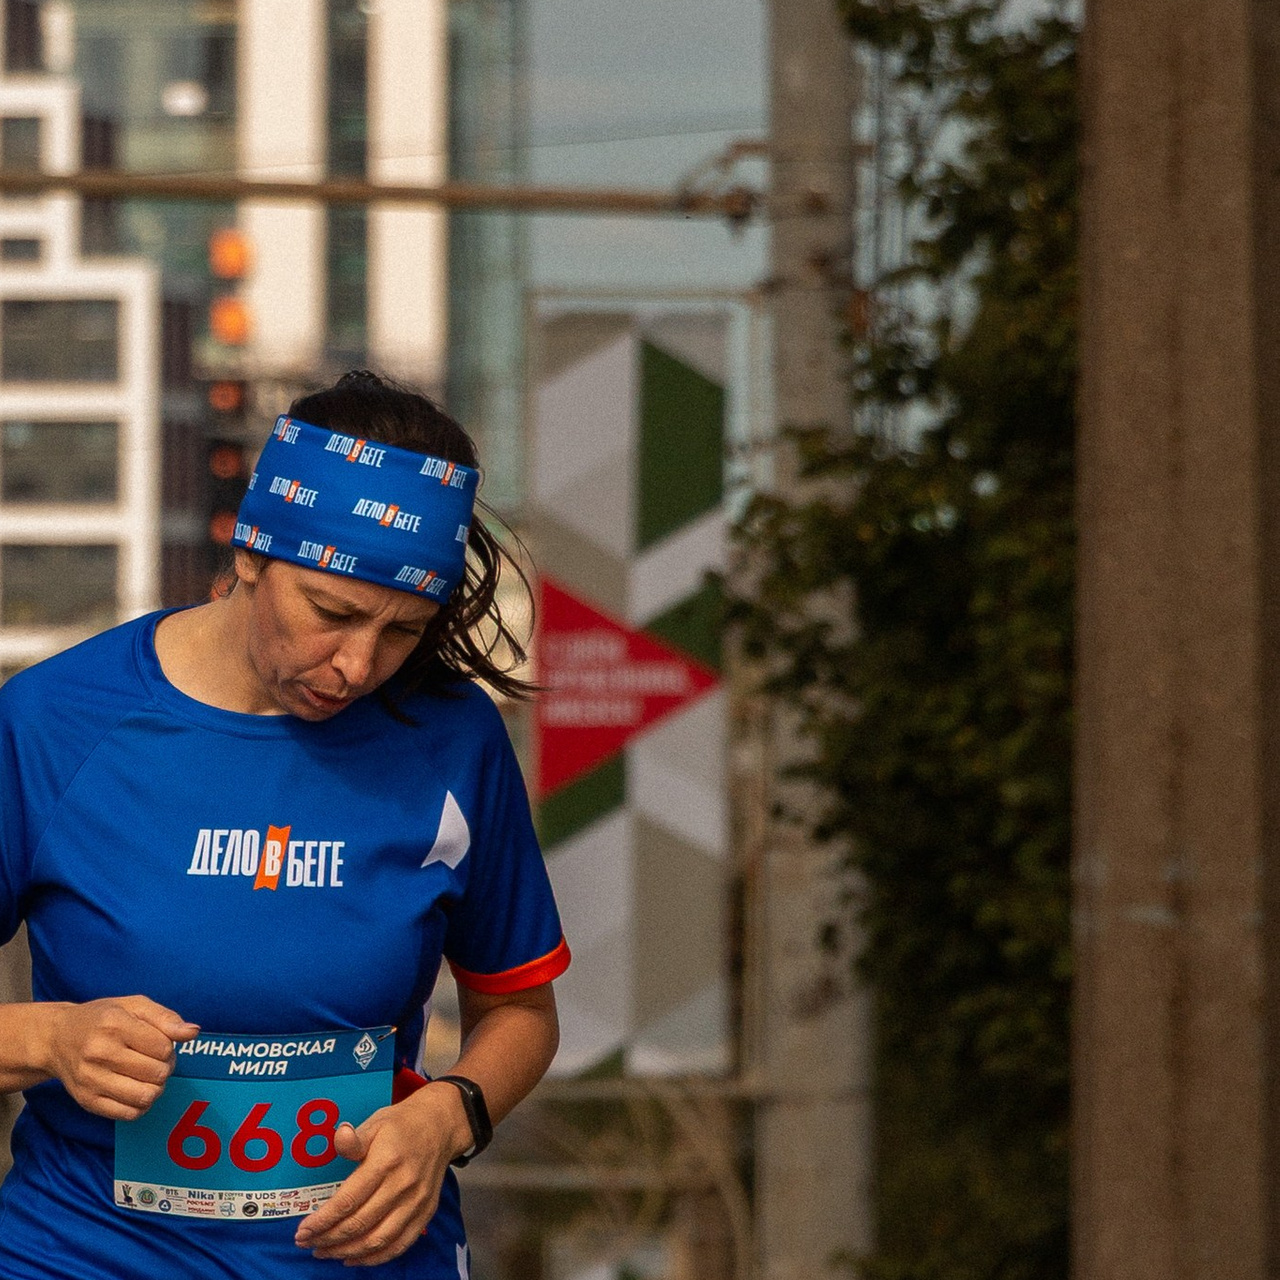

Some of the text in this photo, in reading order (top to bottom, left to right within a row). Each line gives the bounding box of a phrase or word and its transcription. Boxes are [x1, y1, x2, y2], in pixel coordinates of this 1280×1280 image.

[324, 433, 355, 455] ДЕЛО
[358, 445, 387, 468] БЕГЕ
[351, 498, 386, 520] ДЕЛО
[393, 511, 422, 533] БЕГЕ
[297, 540, 324, 561] ДЕЛО
[330, 552, 359, 573] БЕГЕ
[187, 829, 261, 876] ДЕЛО
[286, 840, 346, 887] БЕГЕ
[178, 1038, 336, 1058] ДИНАМОВСКАЯ
[228, 1060, 288, 1075] МИЛЯ
[167, 1098, 340, 1172] 668
[187, 1190, 215, 1200] Nika
[254, 1192, 276, 1200] UDS
[262, 1208, 291, 1217] Effort
